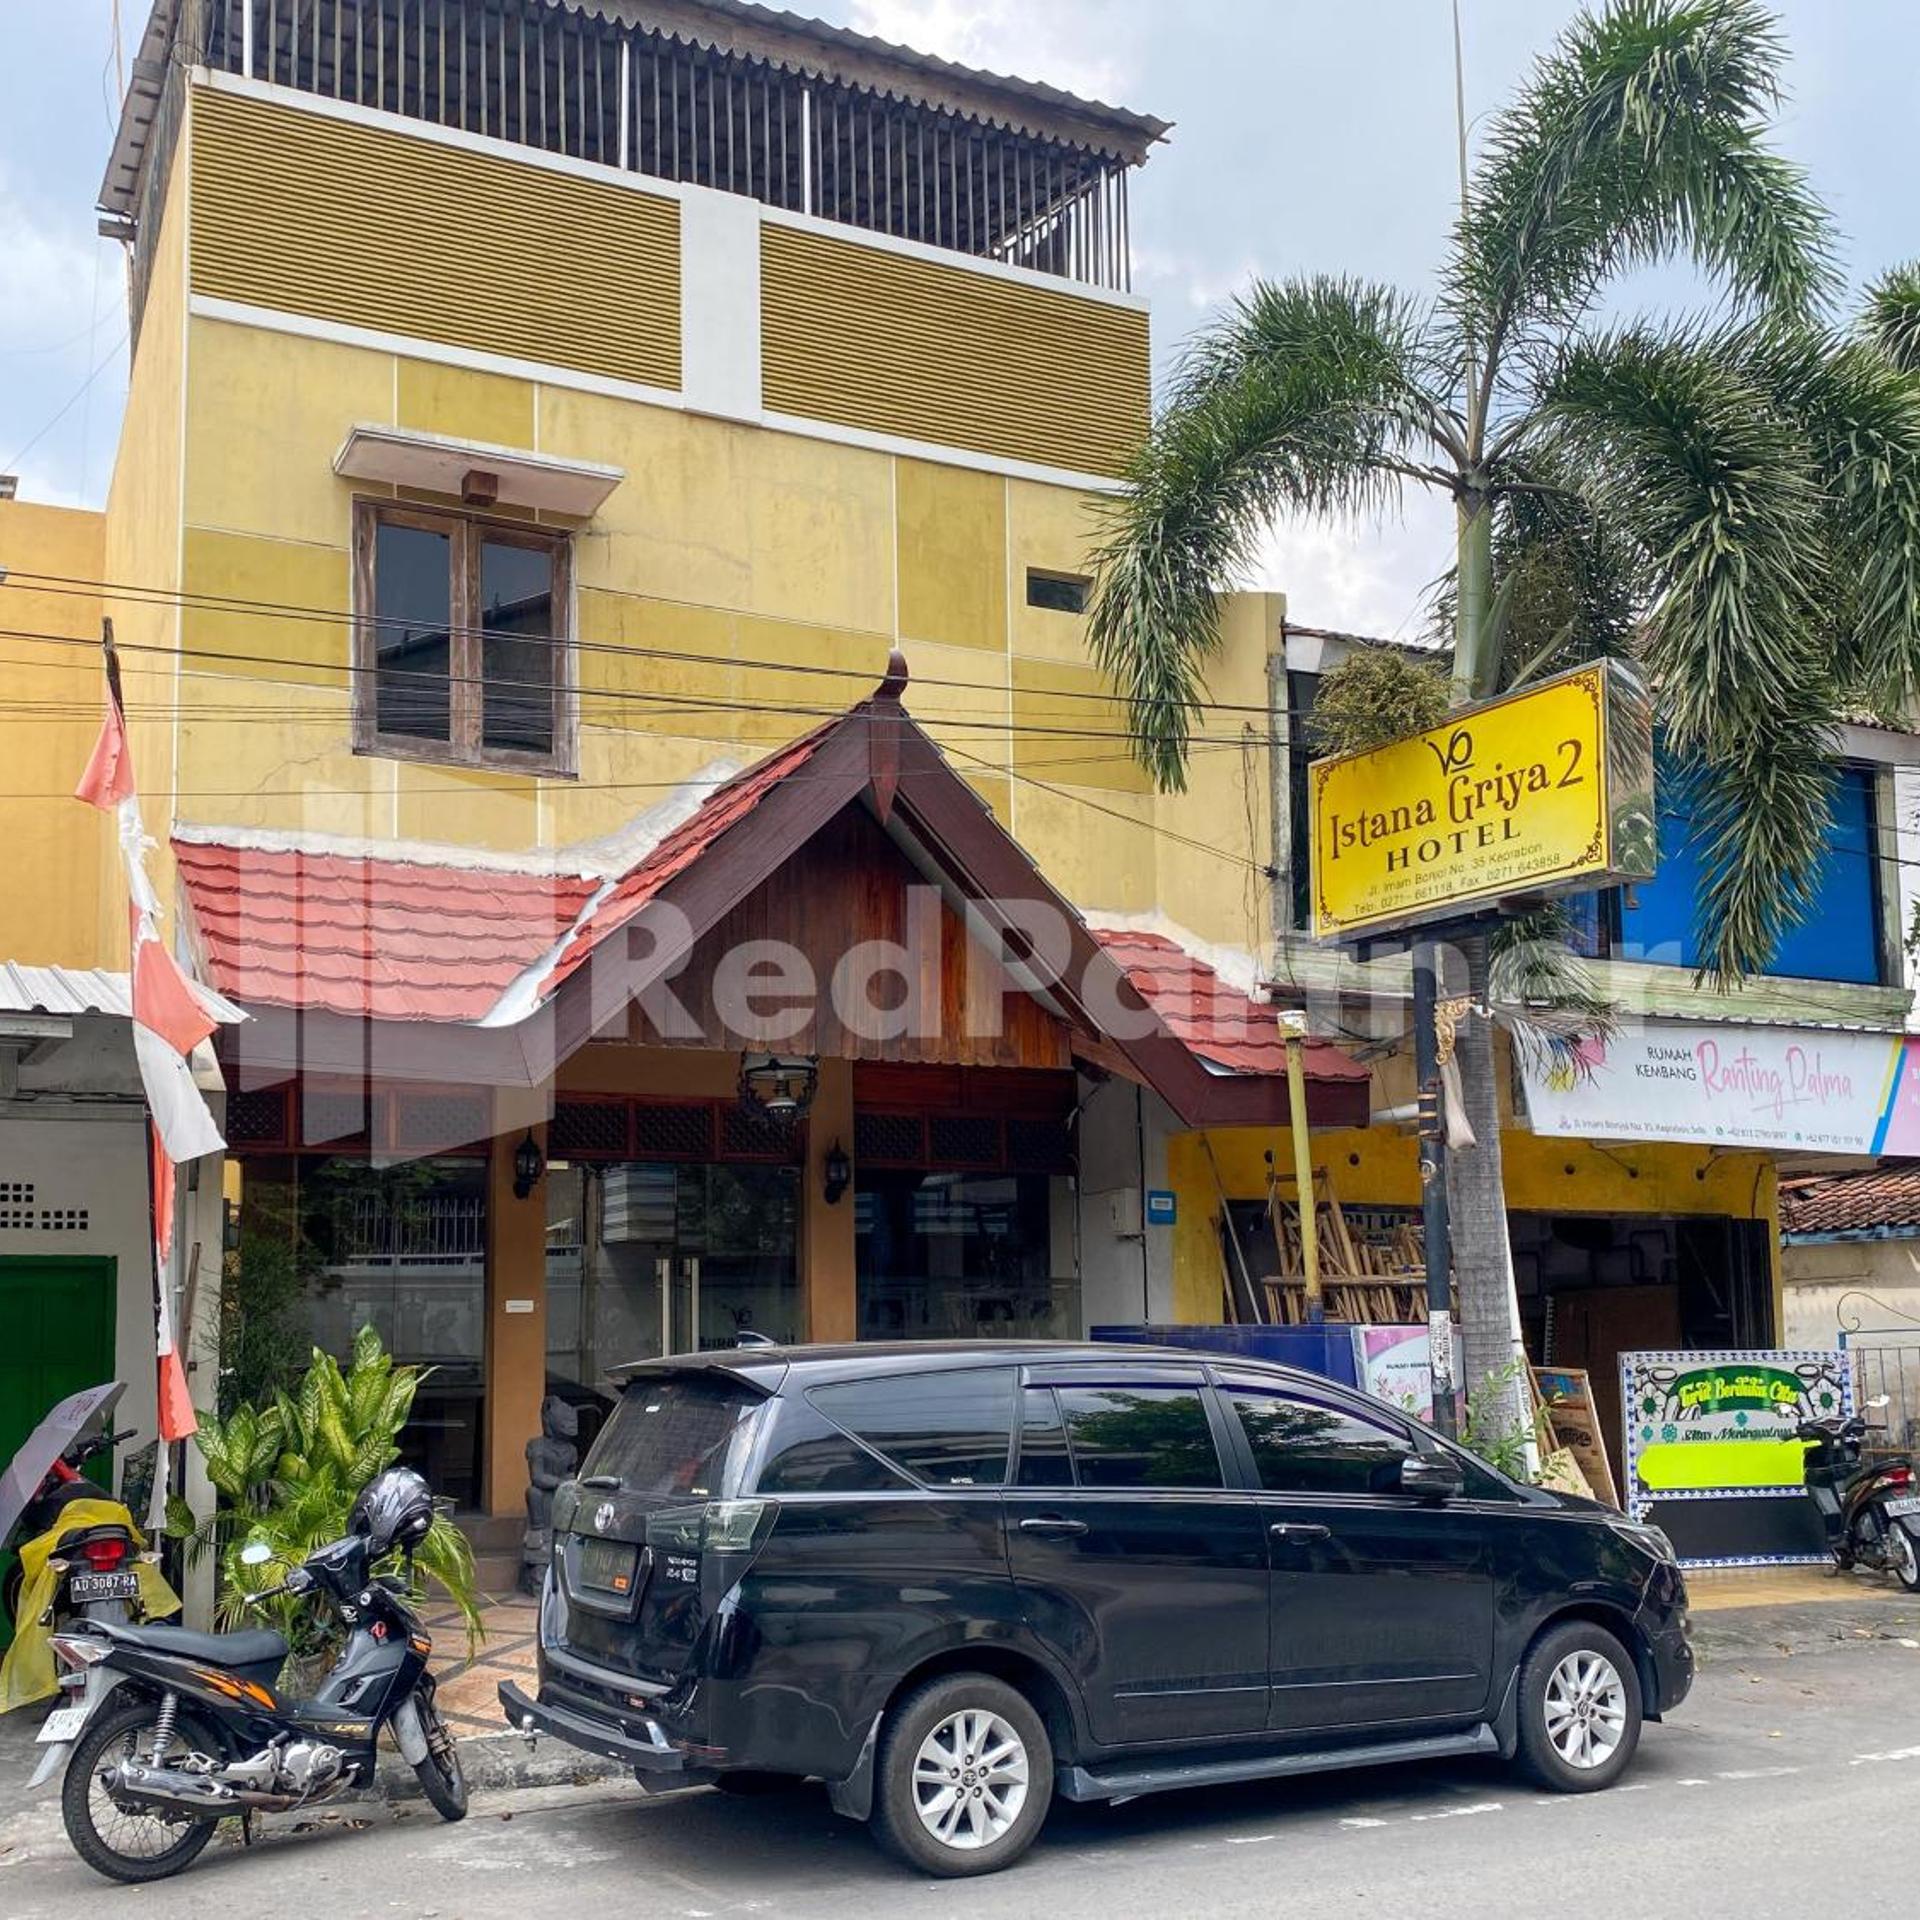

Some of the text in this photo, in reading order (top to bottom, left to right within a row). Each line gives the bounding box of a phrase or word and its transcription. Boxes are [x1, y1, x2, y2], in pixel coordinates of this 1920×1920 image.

[1331, 738, 1584, 860] Istana Griya 2
[1387, 818, 1522, 872] HOTEL
[1384, 878, 1411, 892] Imam
[1415, 869, 1448, 886] Bonjol
[1487, 866, 1513, 882] 0271
[1518, 854, 1561, 875] 643858
[1647, 1046, 1693, 1062] RUMAH
[1635, 1064, 1697, 1081] KEMBANG
[1697, 1039, 1854, 1120] Ranting Palma
[92, 1575, 119, 1590] 3087
